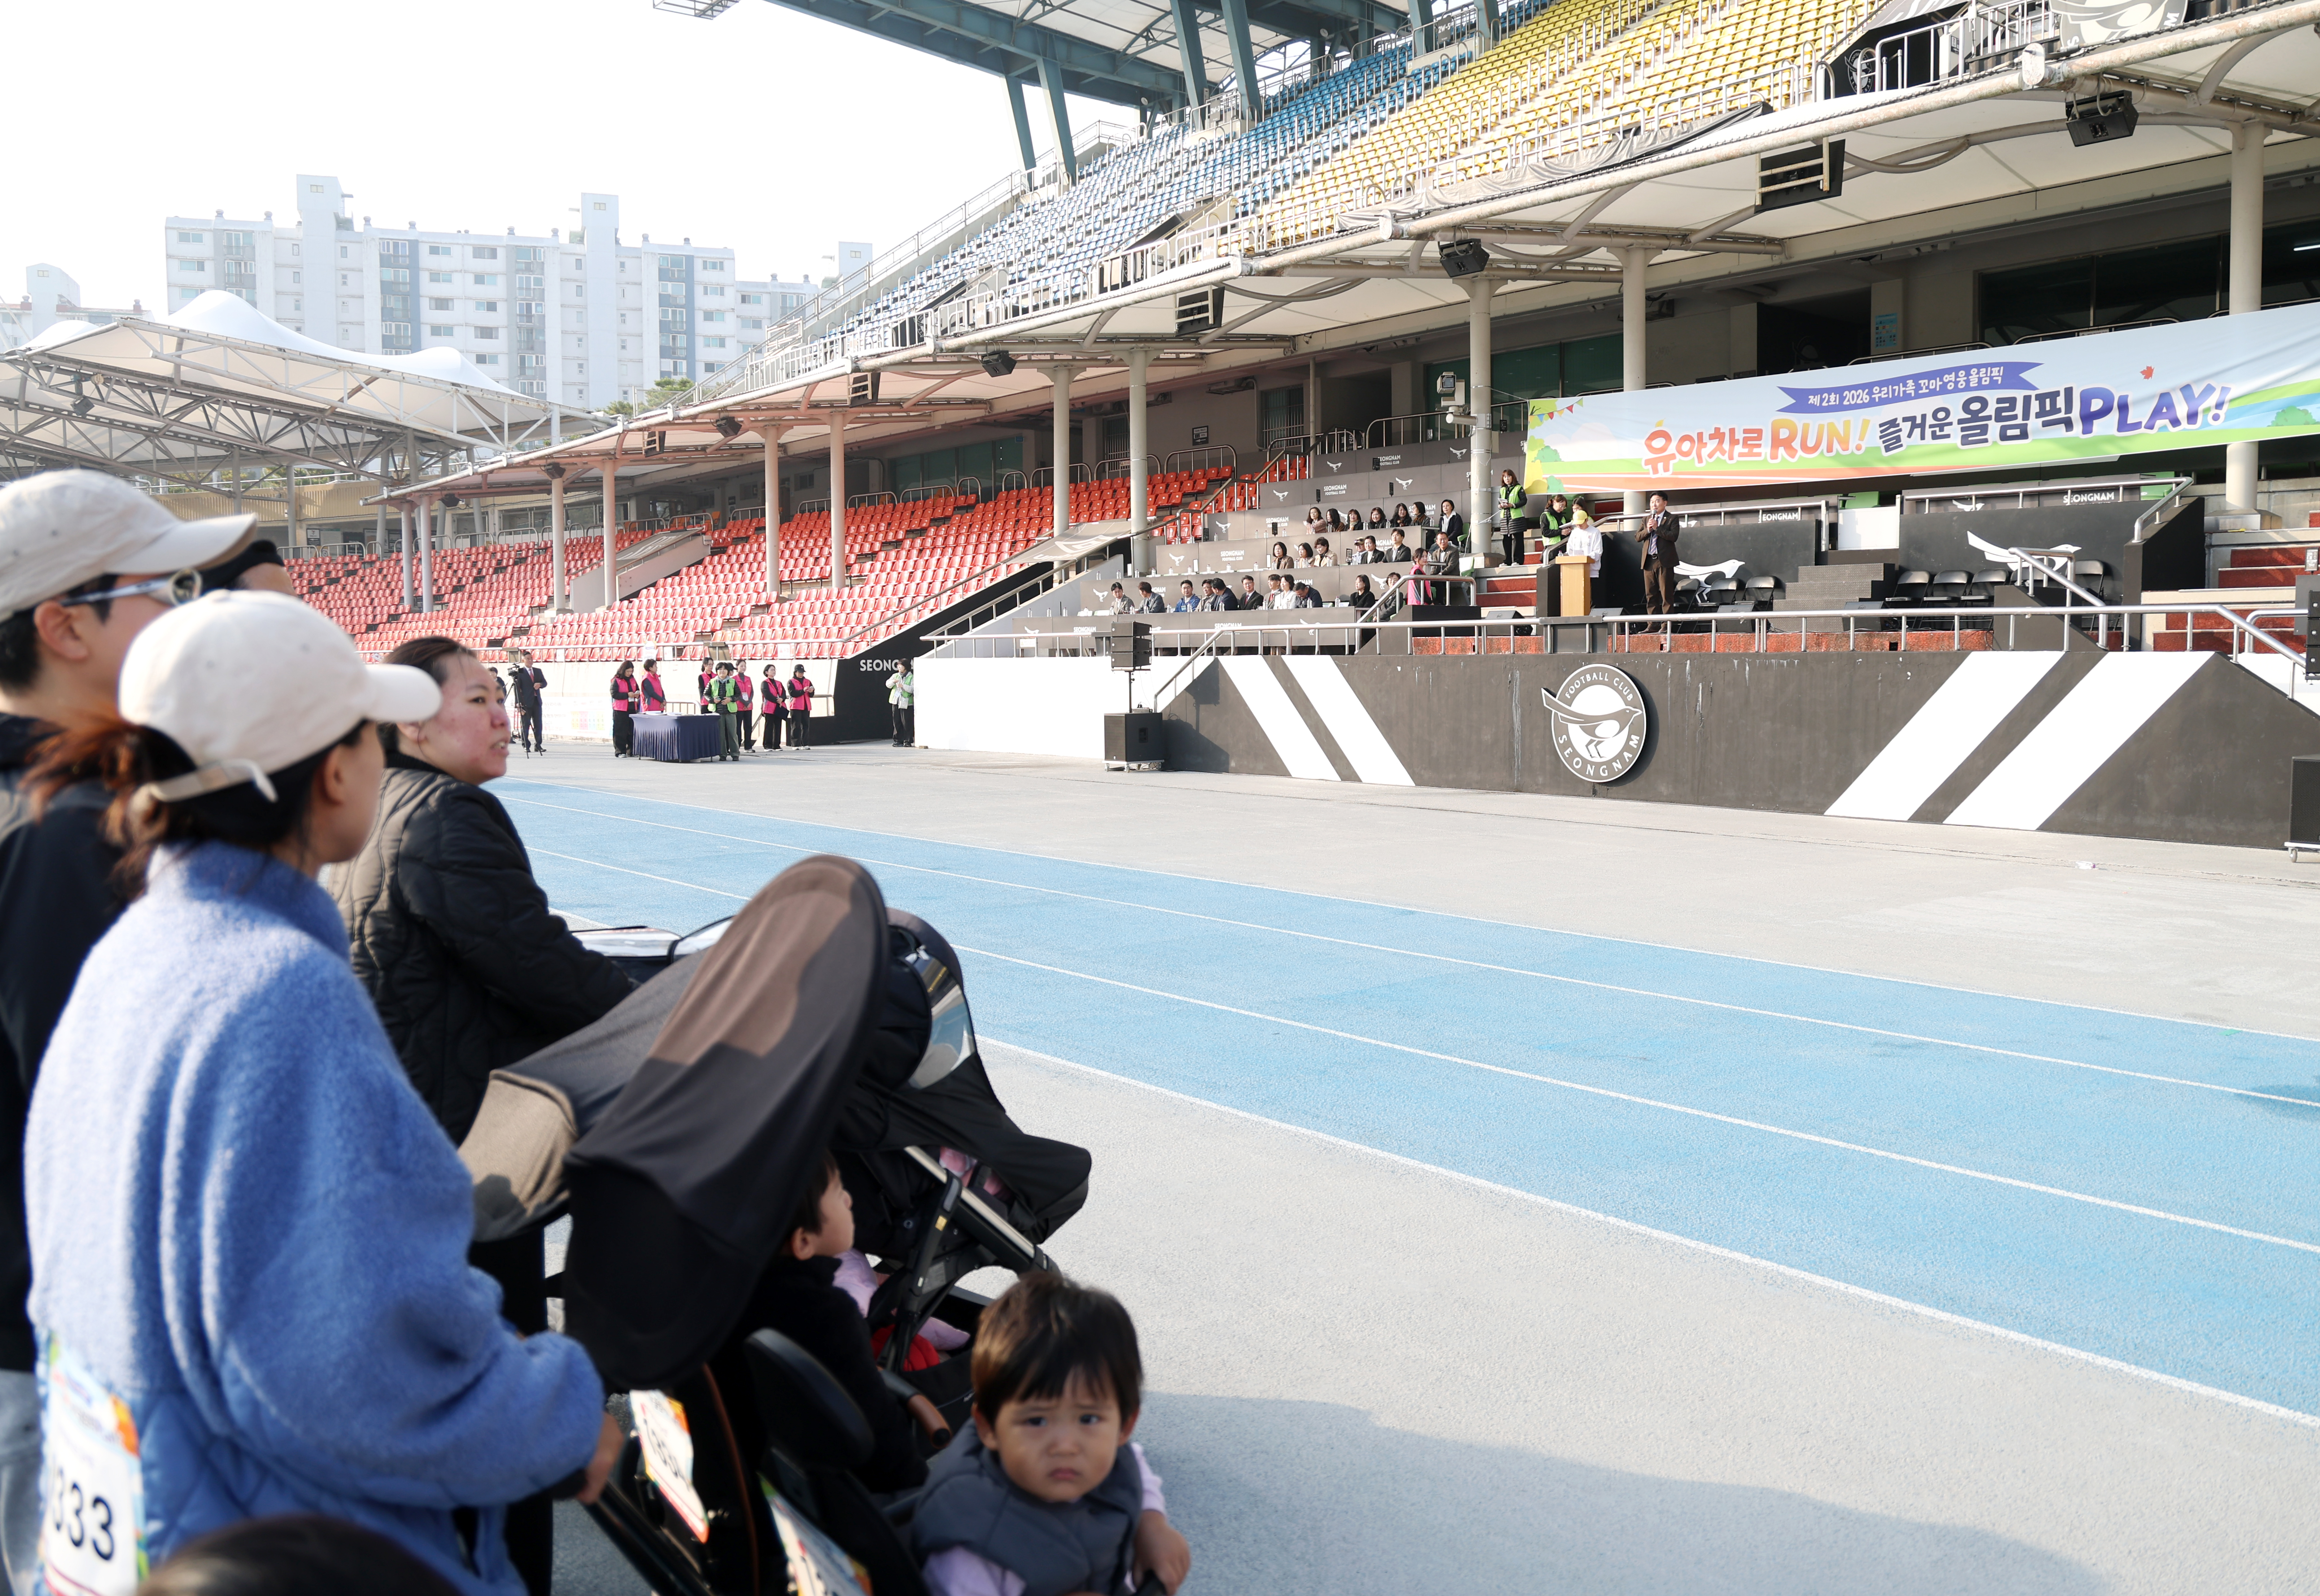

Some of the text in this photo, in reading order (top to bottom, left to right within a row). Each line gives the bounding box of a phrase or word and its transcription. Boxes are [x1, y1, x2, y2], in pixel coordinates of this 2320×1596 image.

[1843, 389, 1870, 405] 2026
[1871, 379, 1916, 402] 우리가족
[1770, 418, 1871, 460] RUN!
[2063, 492, 2114, 503] SONGNAM
[1759, 512, 1798, 521] EONGNAM
[1565, 672, 1634, 701] FOOTBALL CLUB
[1558, 734, 1640, 776] SEONGNAM
